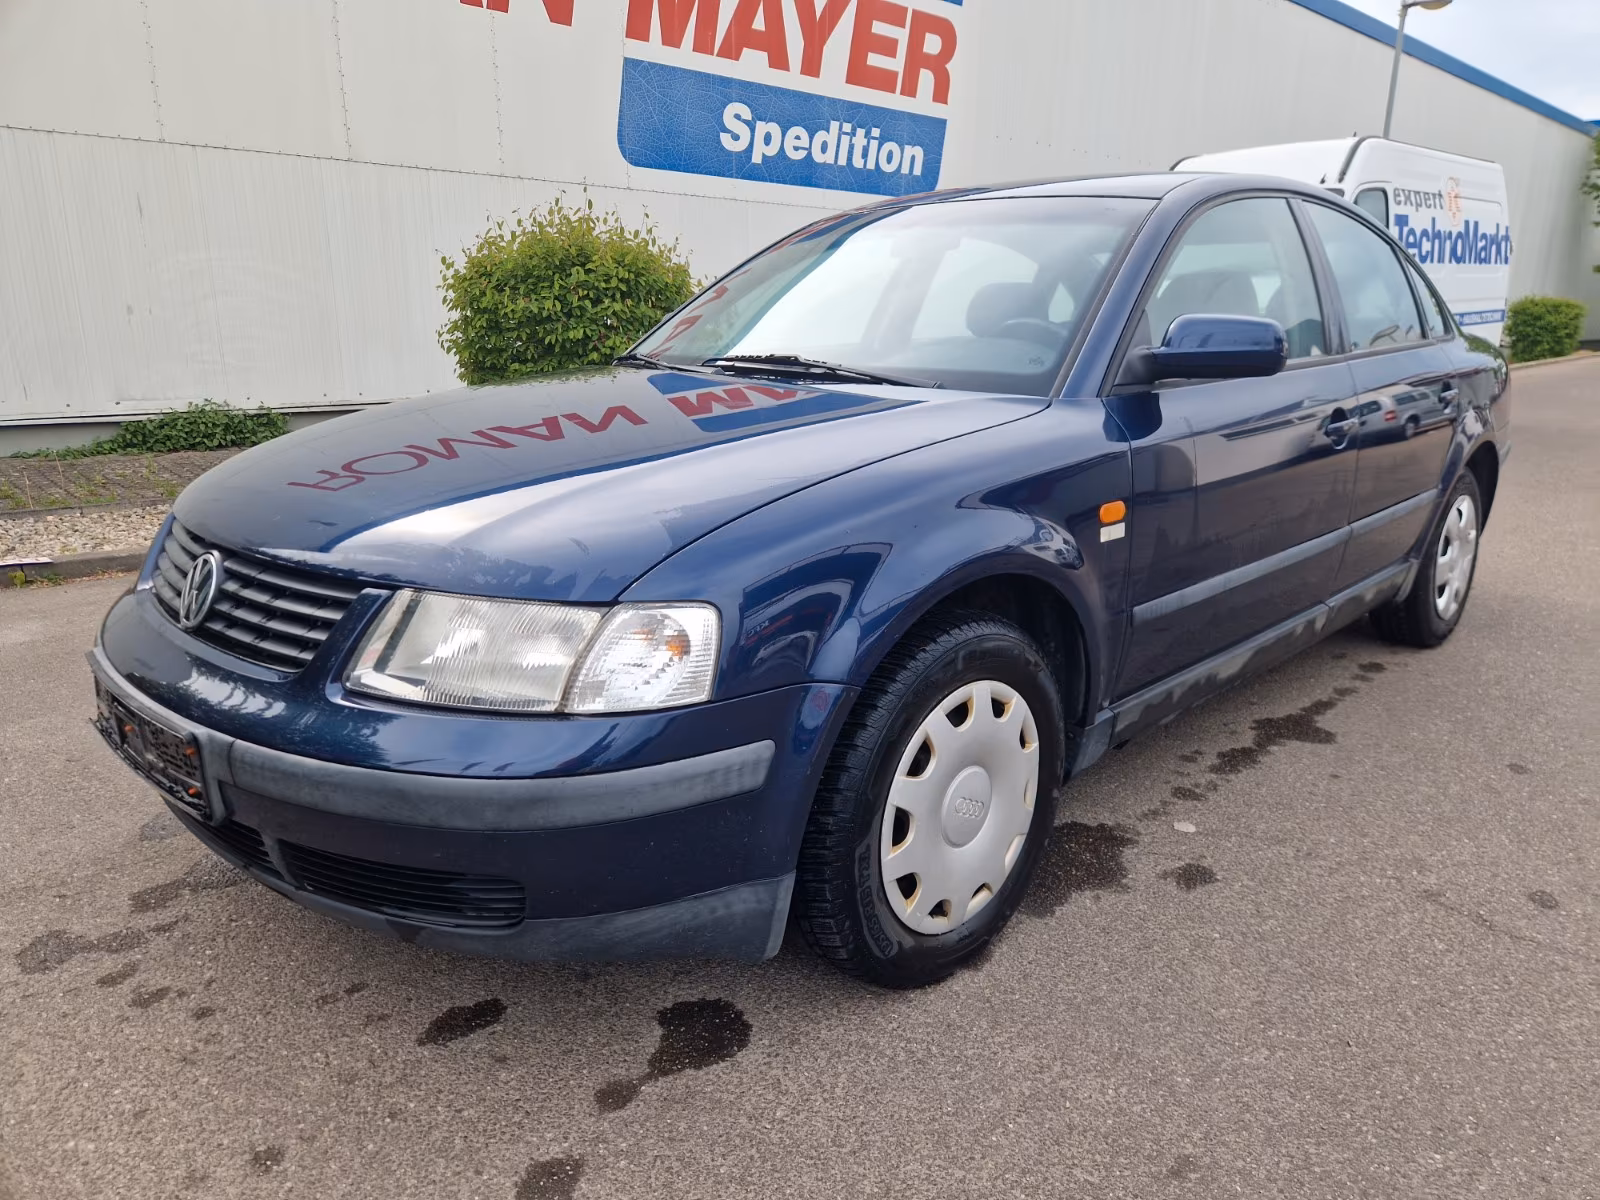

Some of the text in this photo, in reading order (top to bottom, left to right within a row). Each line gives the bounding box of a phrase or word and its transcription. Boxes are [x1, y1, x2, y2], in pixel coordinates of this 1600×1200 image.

[625, 0, 958, 105] MAYER
[719, 102, 924, 176] Spedition
[1393, 187, 1444, 212] expert
[1394, 213, 1510, 265] TechnoMarkt
